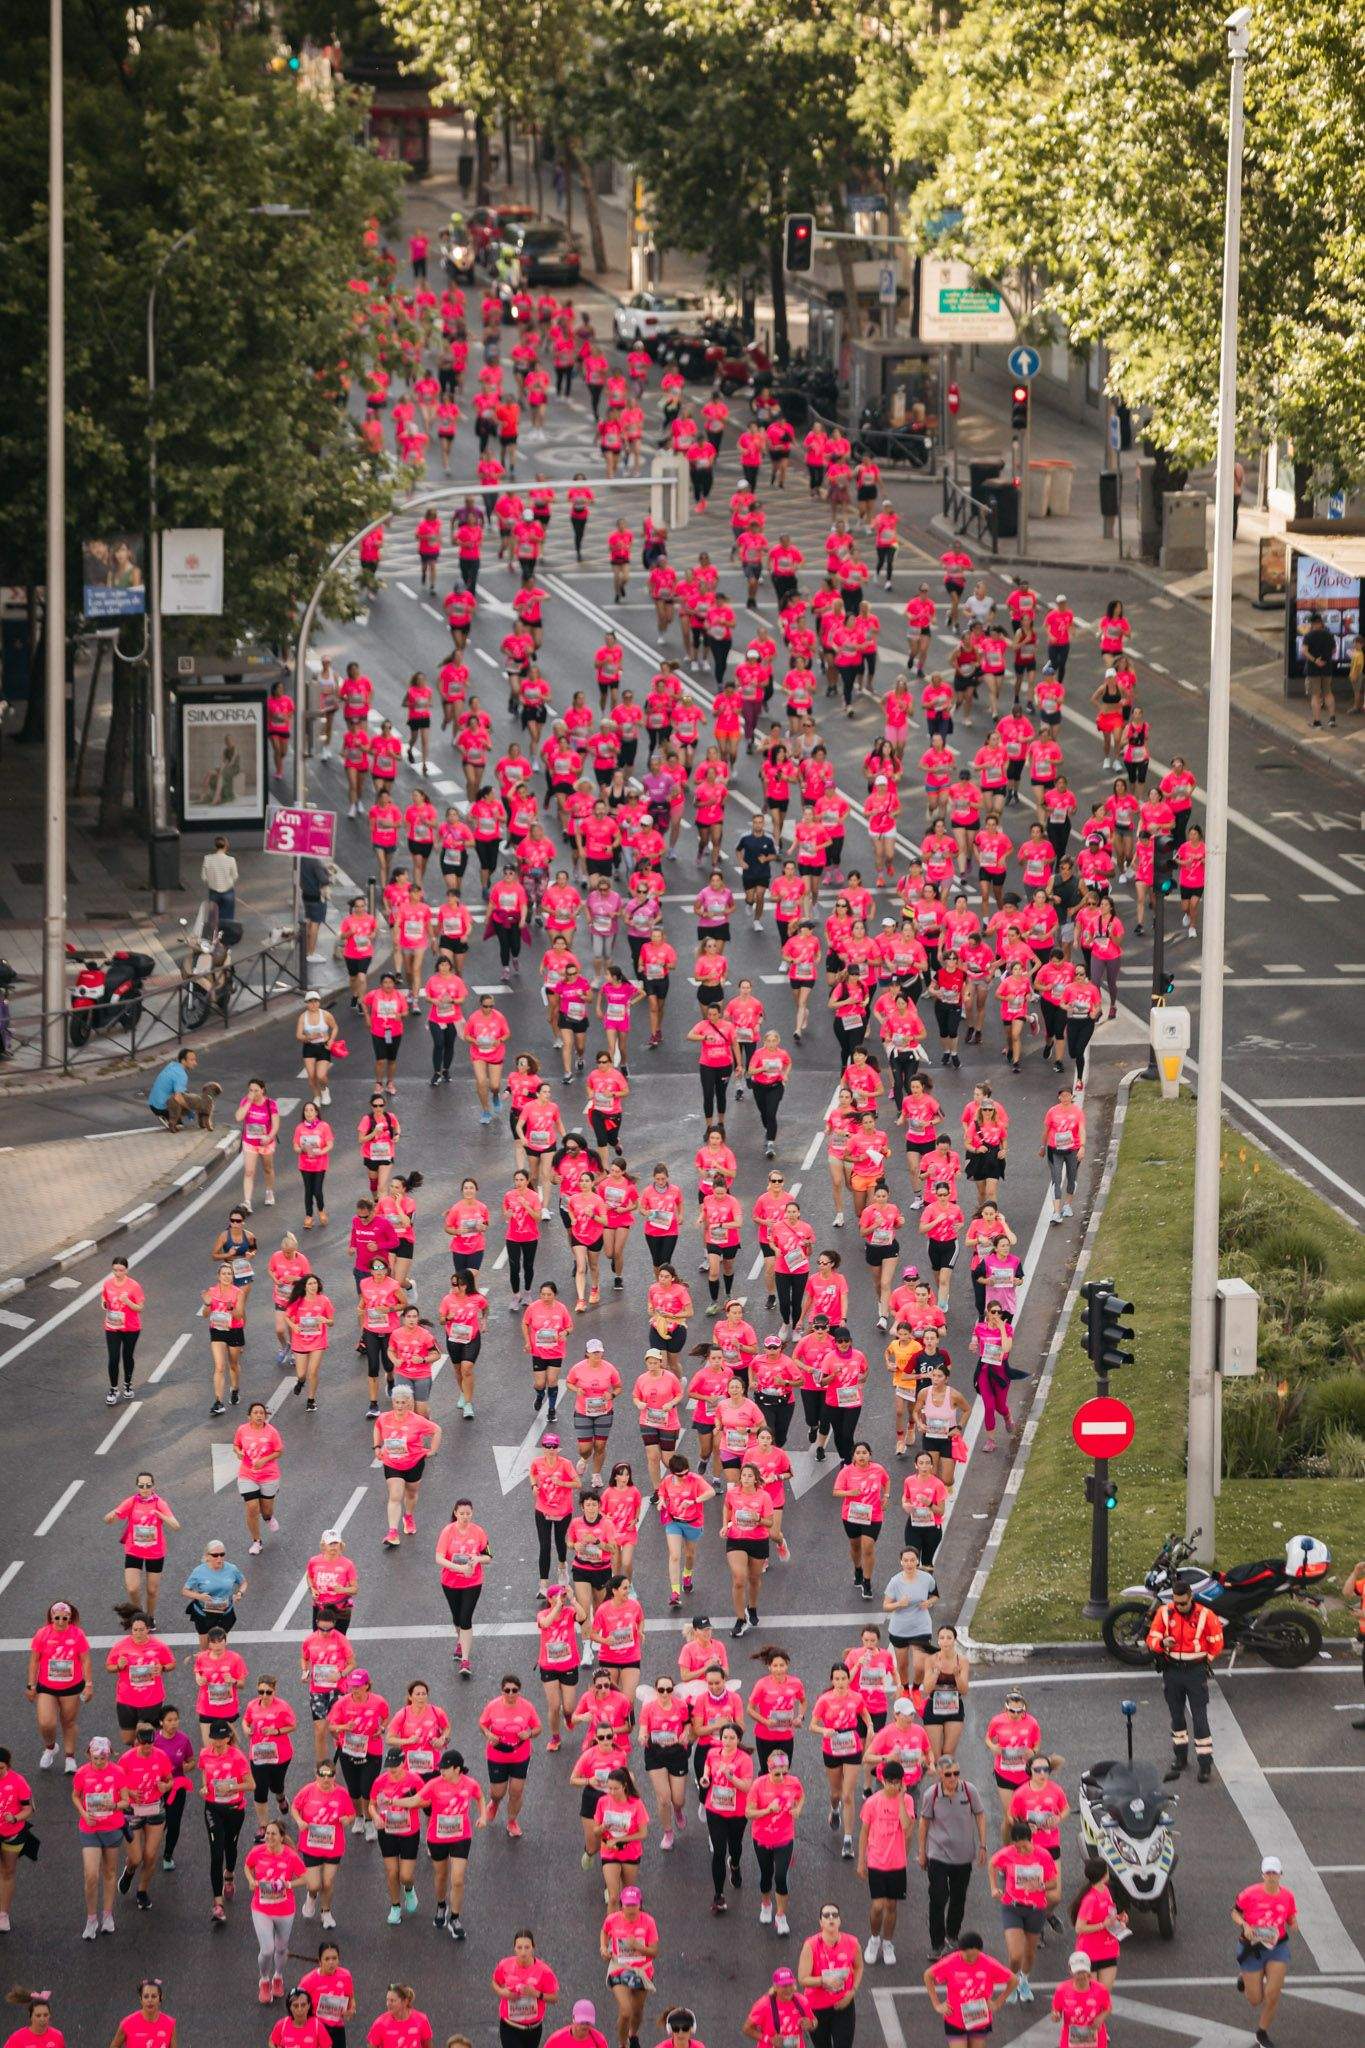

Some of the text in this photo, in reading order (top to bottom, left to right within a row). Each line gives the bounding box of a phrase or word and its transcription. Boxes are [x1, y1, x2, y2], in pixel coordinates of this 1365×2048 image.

[187, 708, 256, 722] SIMORRA
[275, 810, 301, 825] Km
[277, 825, 295, 851] 3
